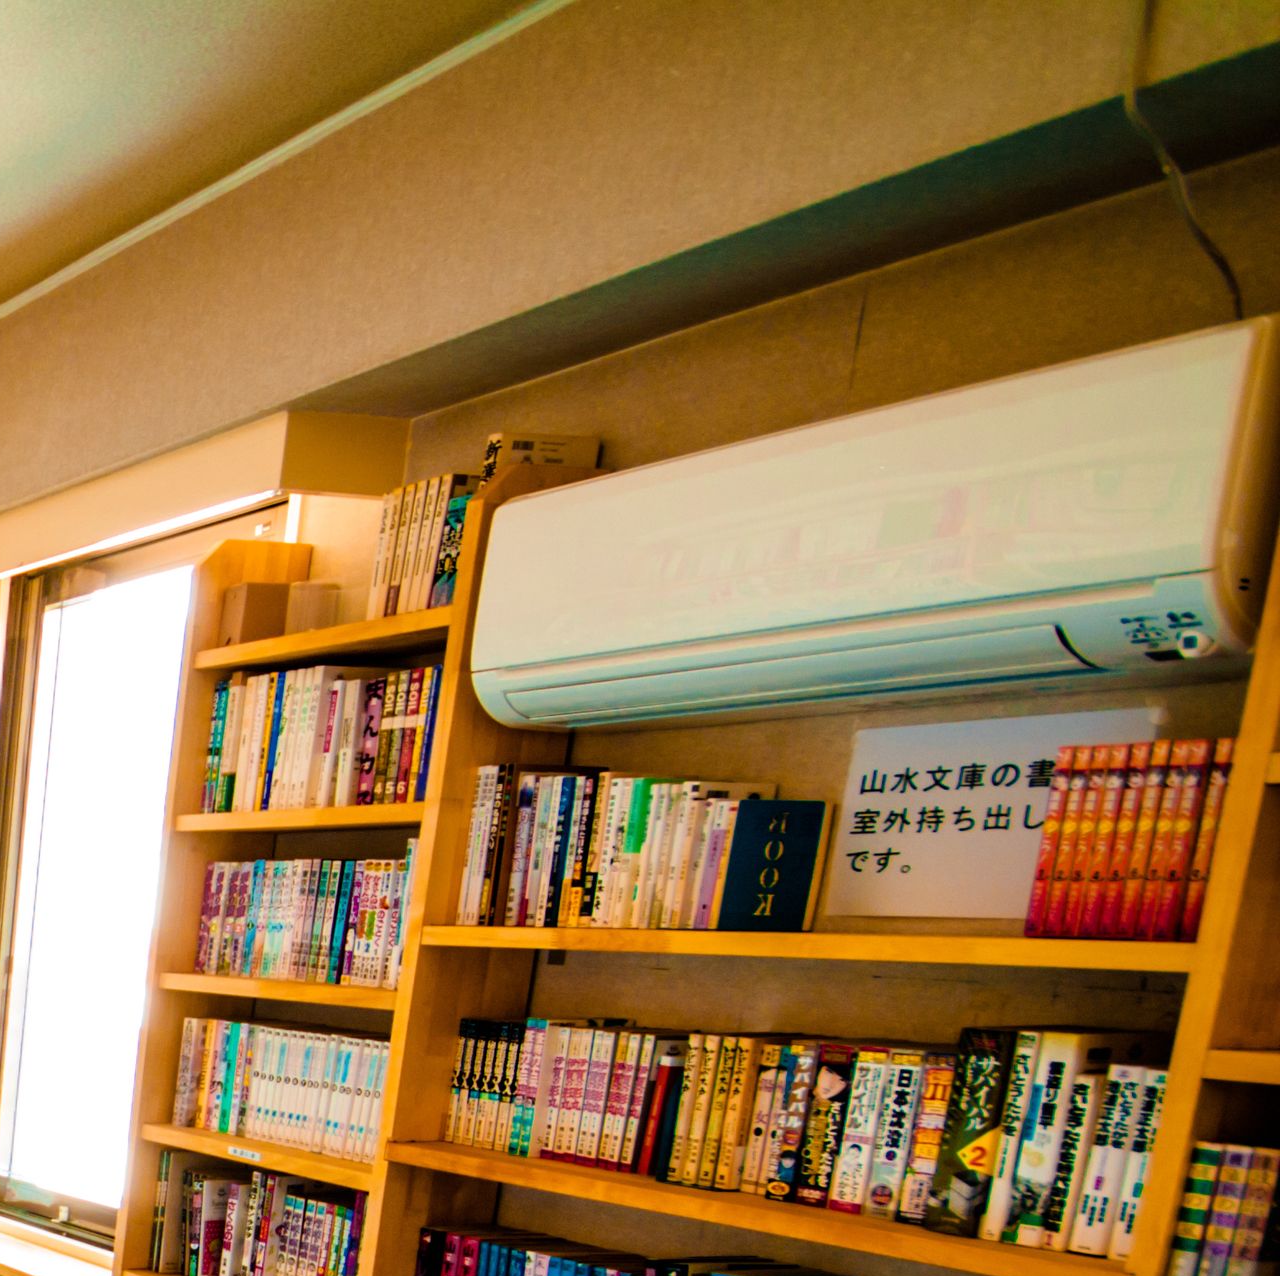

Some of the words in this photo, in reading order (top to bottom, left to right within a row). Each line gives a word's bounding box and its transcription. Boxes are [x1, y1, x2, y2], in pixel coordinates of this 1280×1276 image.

[383, 686, 397, 716] SOIL
[394, 683, 407, 715] SOIL
[407, 682, 420, 714] SOIL
[374, 782, 383, 793] 4
[385, 782, 394, 794] 5
[397, 781, 406, 793] 6
[860, 760, 1056, 794] 山水文庫の書
[840, 804, 1045, 834] 室外持ち出し
[846, 848, 911, 873] です。
[847, 1064, 871, 1130] サバイバル
[964, 1054, 1001, 1132] サバイバル
[886, 1069, 914, 1149] 日本沈没
[969, 1146, 987, 1167] 2
